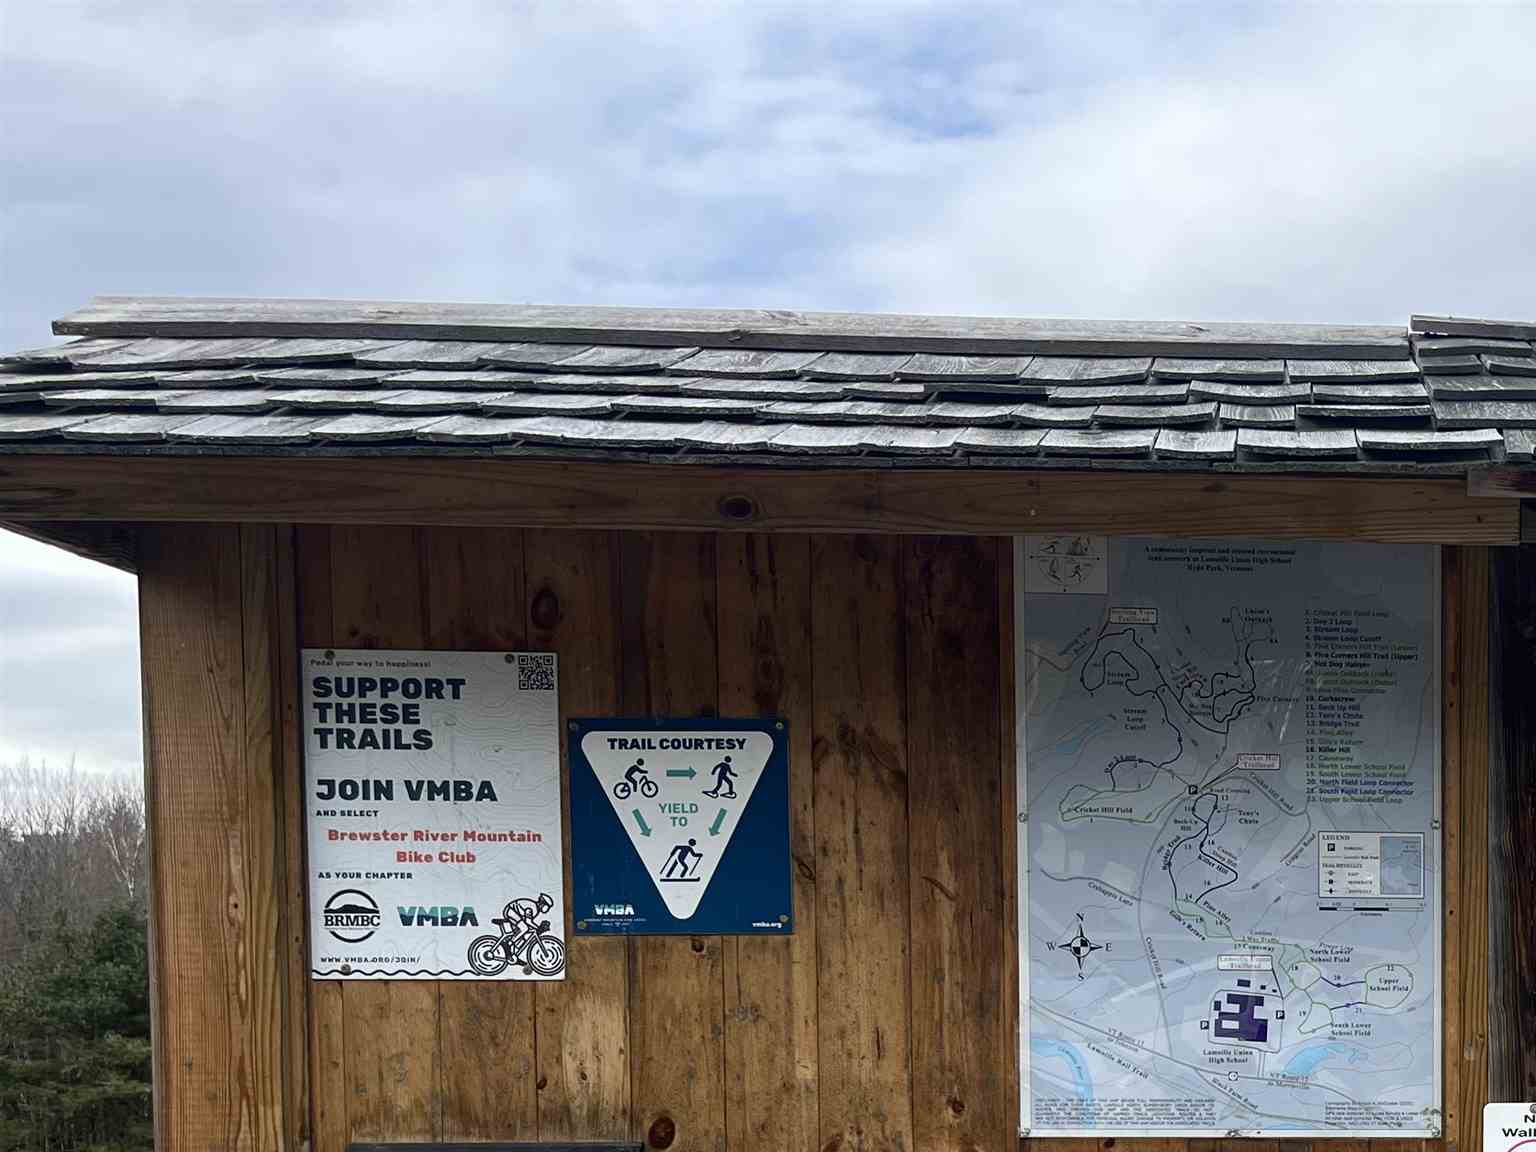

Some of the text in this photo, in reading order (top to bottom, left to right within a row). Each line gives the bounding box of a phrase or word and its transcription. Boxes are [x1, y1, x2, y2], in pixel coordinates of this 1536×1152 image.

[312, 677, 466, 699] SUPPORT
[313, 703, 420, 724] THESE
[314, 729, 433, 750] TRAILS
[607, 738, 746, 749] TRAIL COURTESY
[316, 779, 498, 801] JOIN VMBA
[659, 804, 698, 813] YIELD
[670, 817, 688, 826] TO
[328, 830, 542, 842] Brewster River Mountain
[397, 851, 476, 863] Bike Club
[397, 906, 478, 926] VMBA
[594, 905, 634, 915] VMBA
[325, 915, 381, 927] BRMBC
